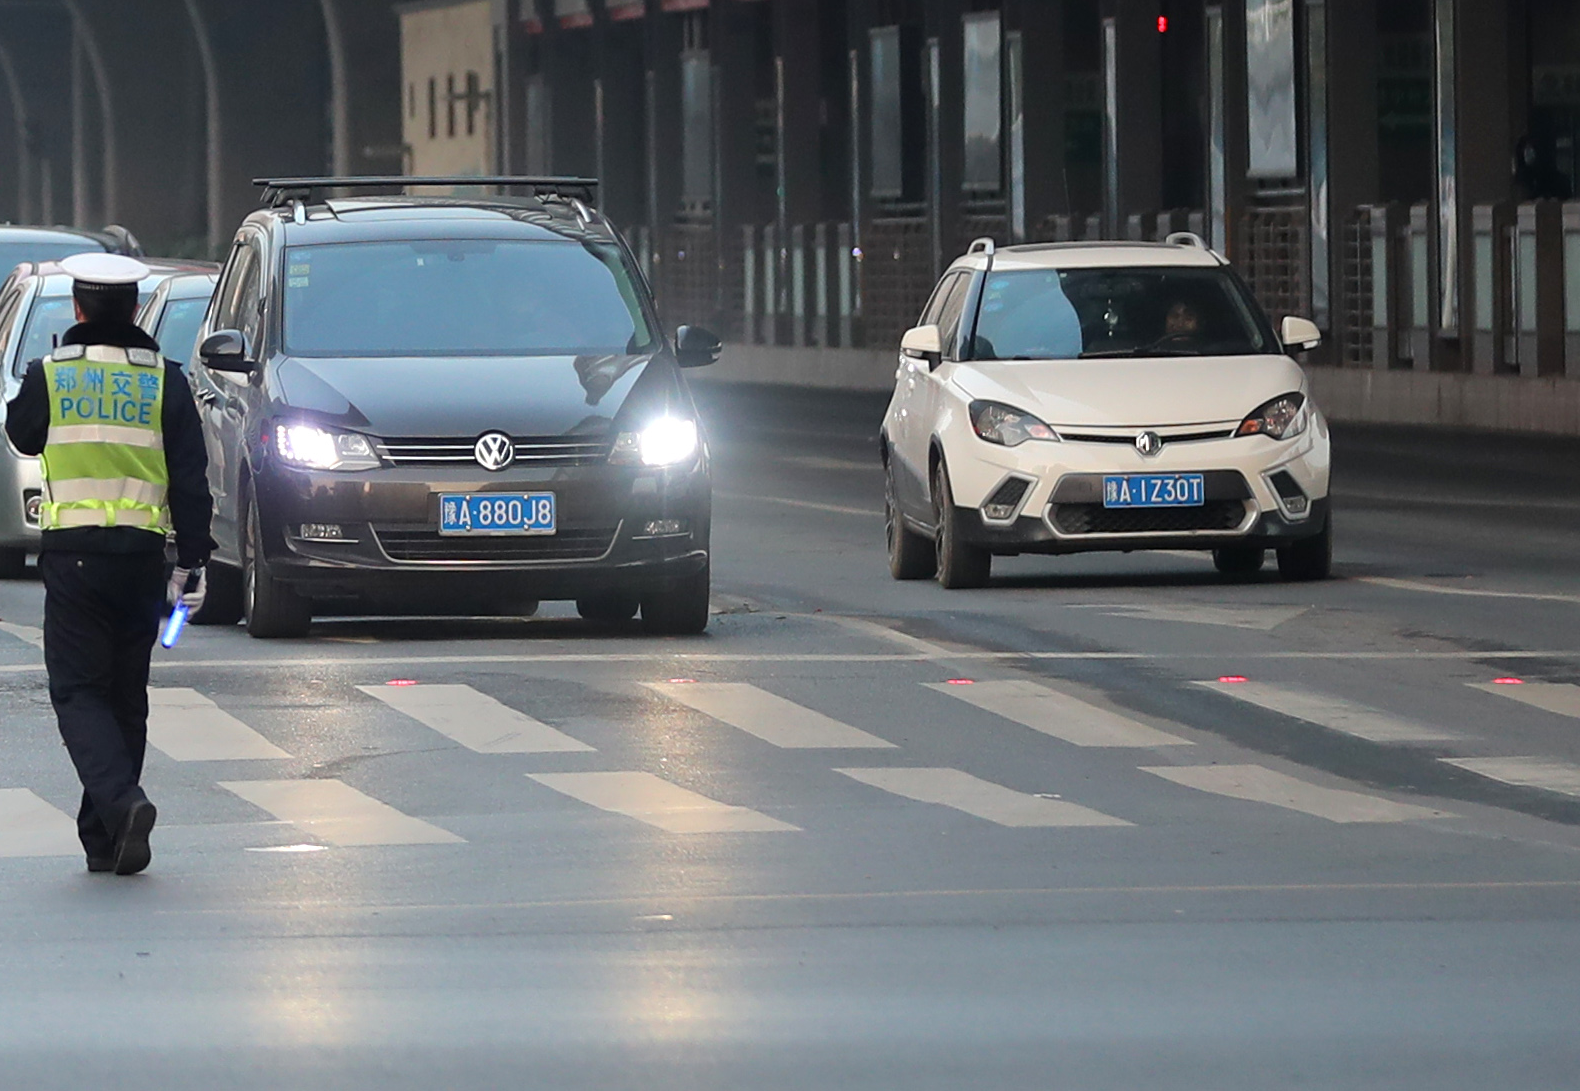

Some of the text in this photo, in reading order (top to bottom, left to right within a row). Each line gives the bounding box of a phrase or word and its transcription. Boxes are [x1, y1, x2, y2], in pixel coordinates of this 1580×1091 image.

[54, 366, 160, 401] 郑州交警
[60, 396, 152, 424] POLICE
